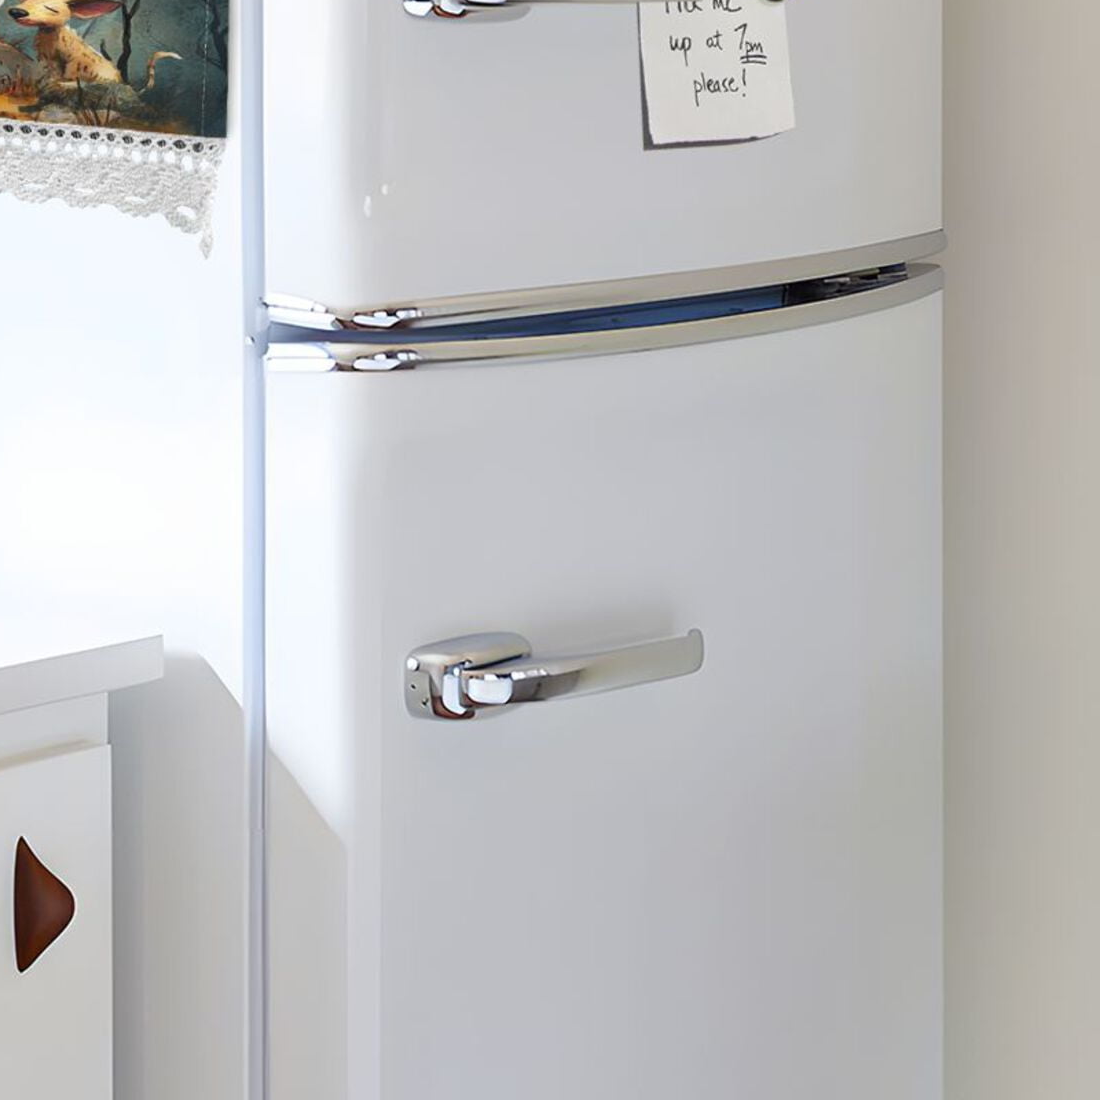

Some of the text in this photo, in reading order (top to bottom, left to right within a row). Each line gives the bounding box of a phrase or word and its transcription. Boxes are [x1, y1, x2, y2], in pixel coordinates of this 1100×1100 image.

[669, 35, 692, 67] up
[706, 30, 723, 51] at
[694, 68, 746, 107] please!
